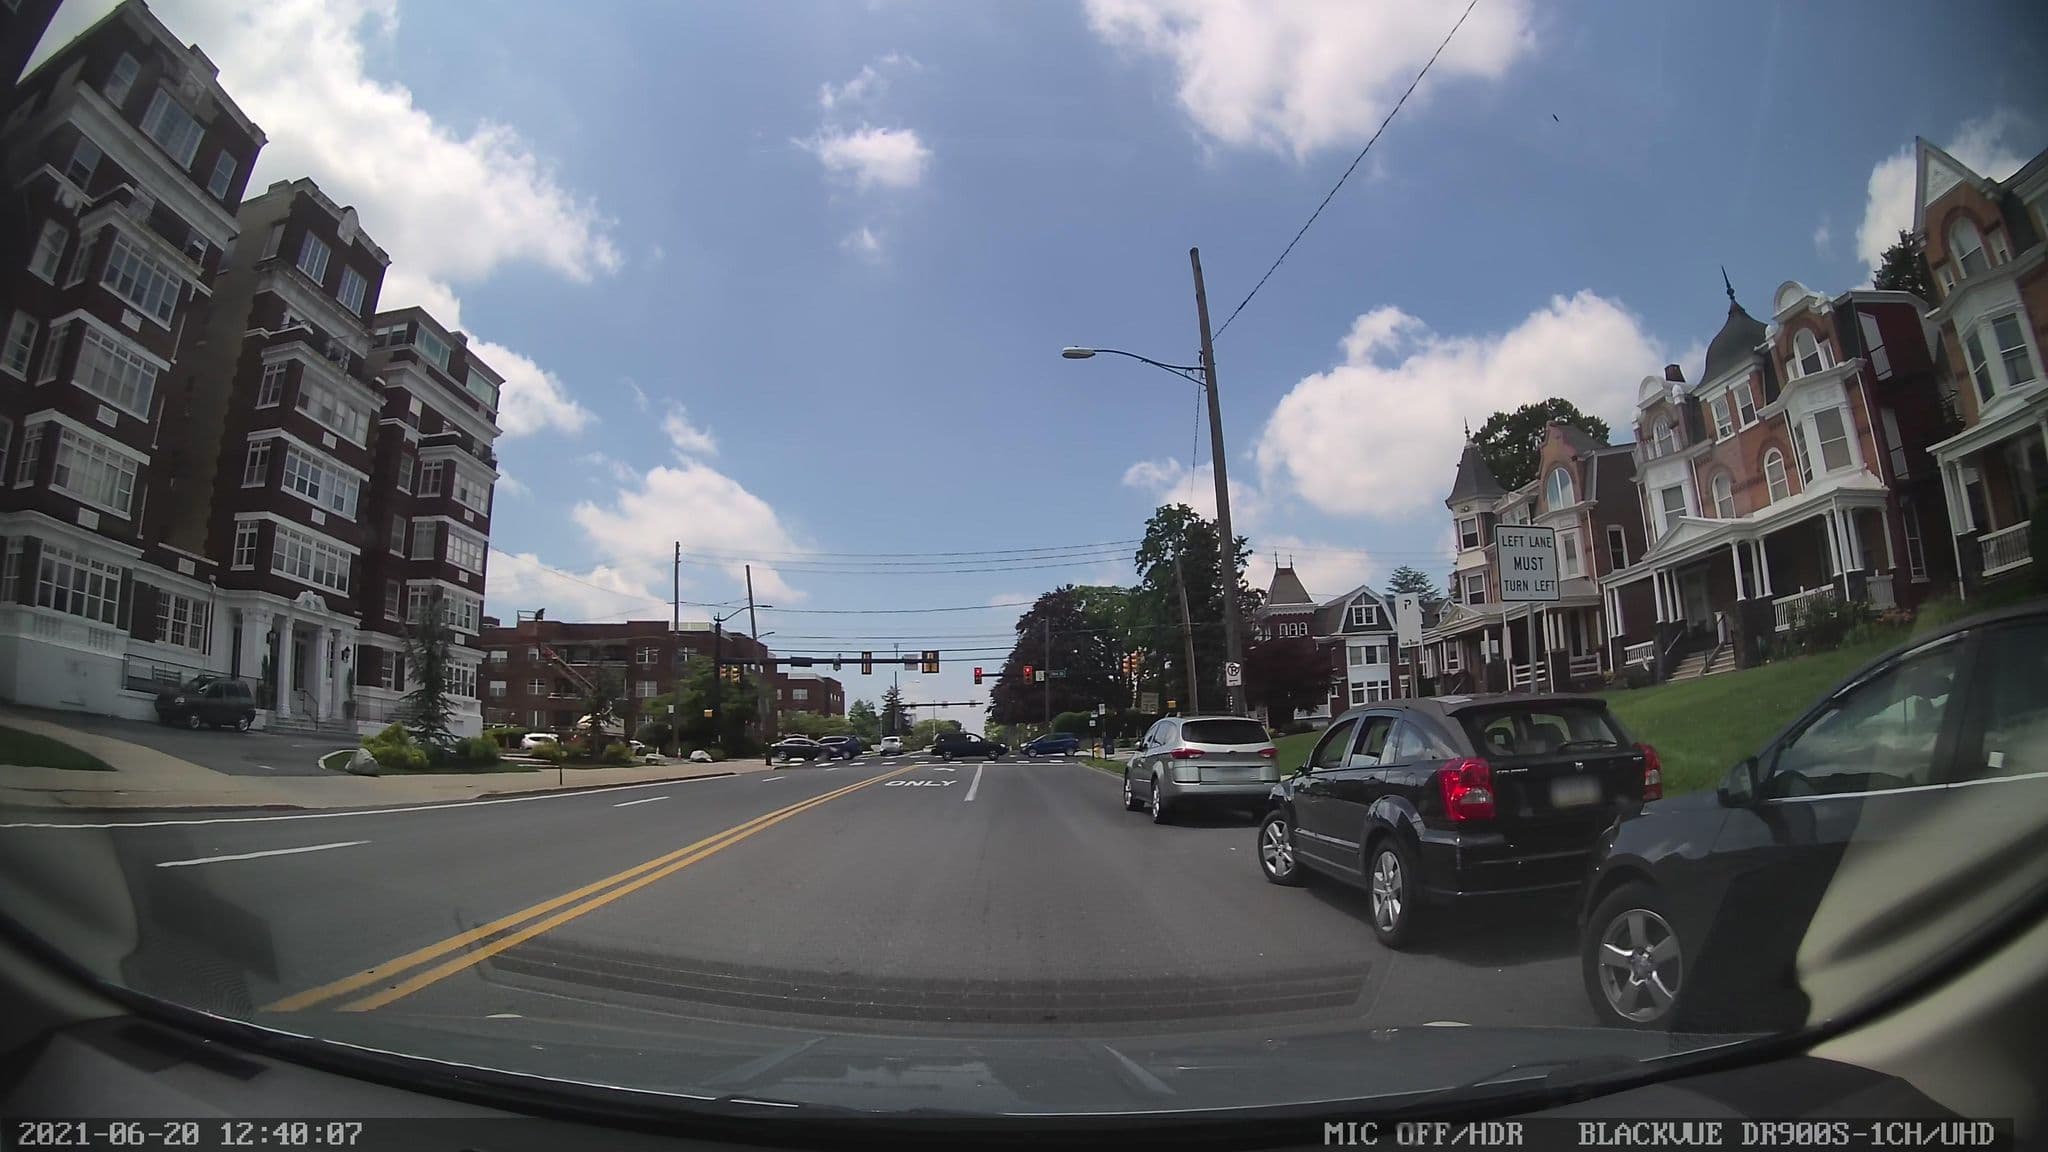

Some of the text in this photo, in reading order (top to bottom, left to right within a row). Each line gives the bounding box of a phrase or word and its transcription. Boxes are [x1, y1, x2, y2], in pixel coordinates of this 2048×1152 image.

[1502, 535, 1552, 548] LEFT LANE
[1514, 556, 1544, 571] MUST
[1504, 580, 1555, 592] TURN LEFT
